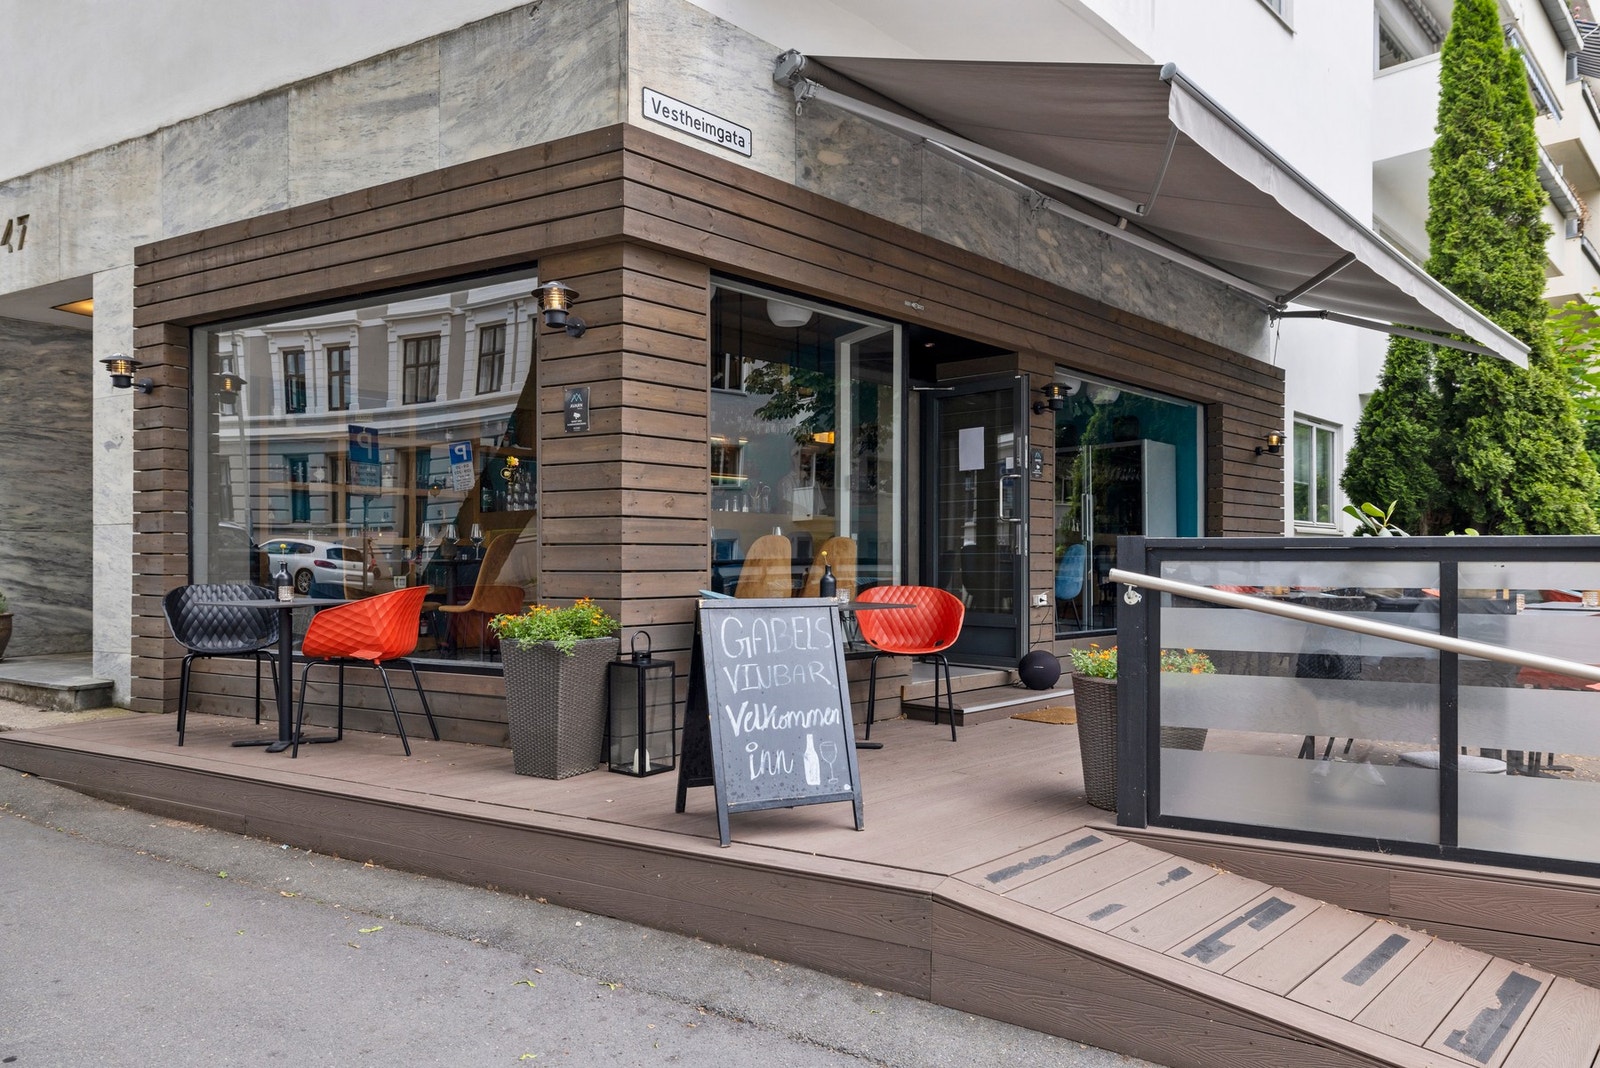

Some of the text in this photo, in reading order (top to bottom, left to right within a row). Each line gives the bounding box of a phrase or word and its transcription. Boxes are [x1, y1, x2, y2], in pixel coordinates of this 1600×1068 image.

[651, 97, 745, 148] Vestheimgata
[0, 214, 30, 253] 47
[720, 616, 833, 658] GABELS
[725, 701, 840, 736] Velkommen
[745, 742, 794, 780] inn
